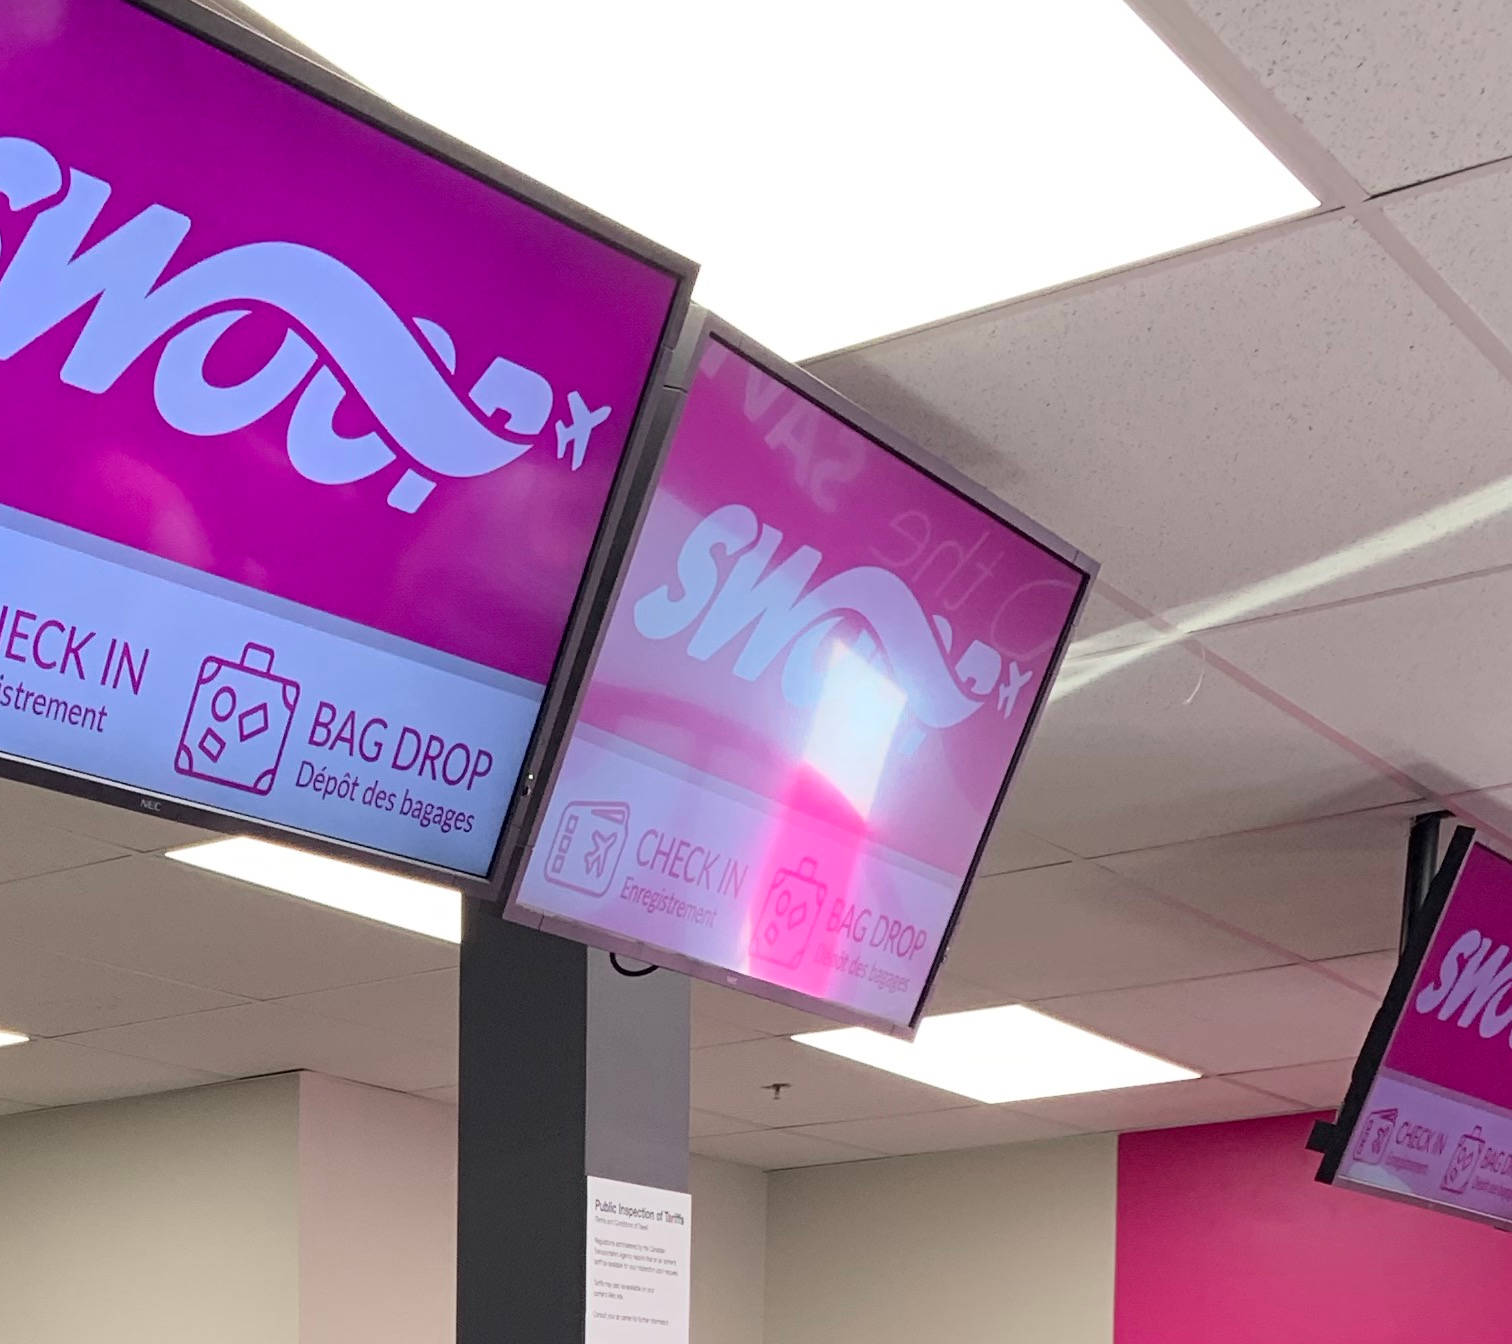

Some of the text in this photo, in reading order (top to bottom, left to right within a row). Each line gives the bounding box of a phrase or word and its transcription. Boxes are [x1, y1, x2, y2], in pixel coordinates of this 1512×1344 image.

[100, 638, 149, 695] IN
[308, 701, 493, 791] BAG DROP
[295, 760, 475, 833] Dépôt des bagages
[636, 828, 749, 899] CHECK IN
[619, 876, 717, 928] Enregistrement
[826, 898, 927, 961] BAG DROP
[595, 1198, 617, 1214] Public
[618, 1203, 656, 1220] Inspection
